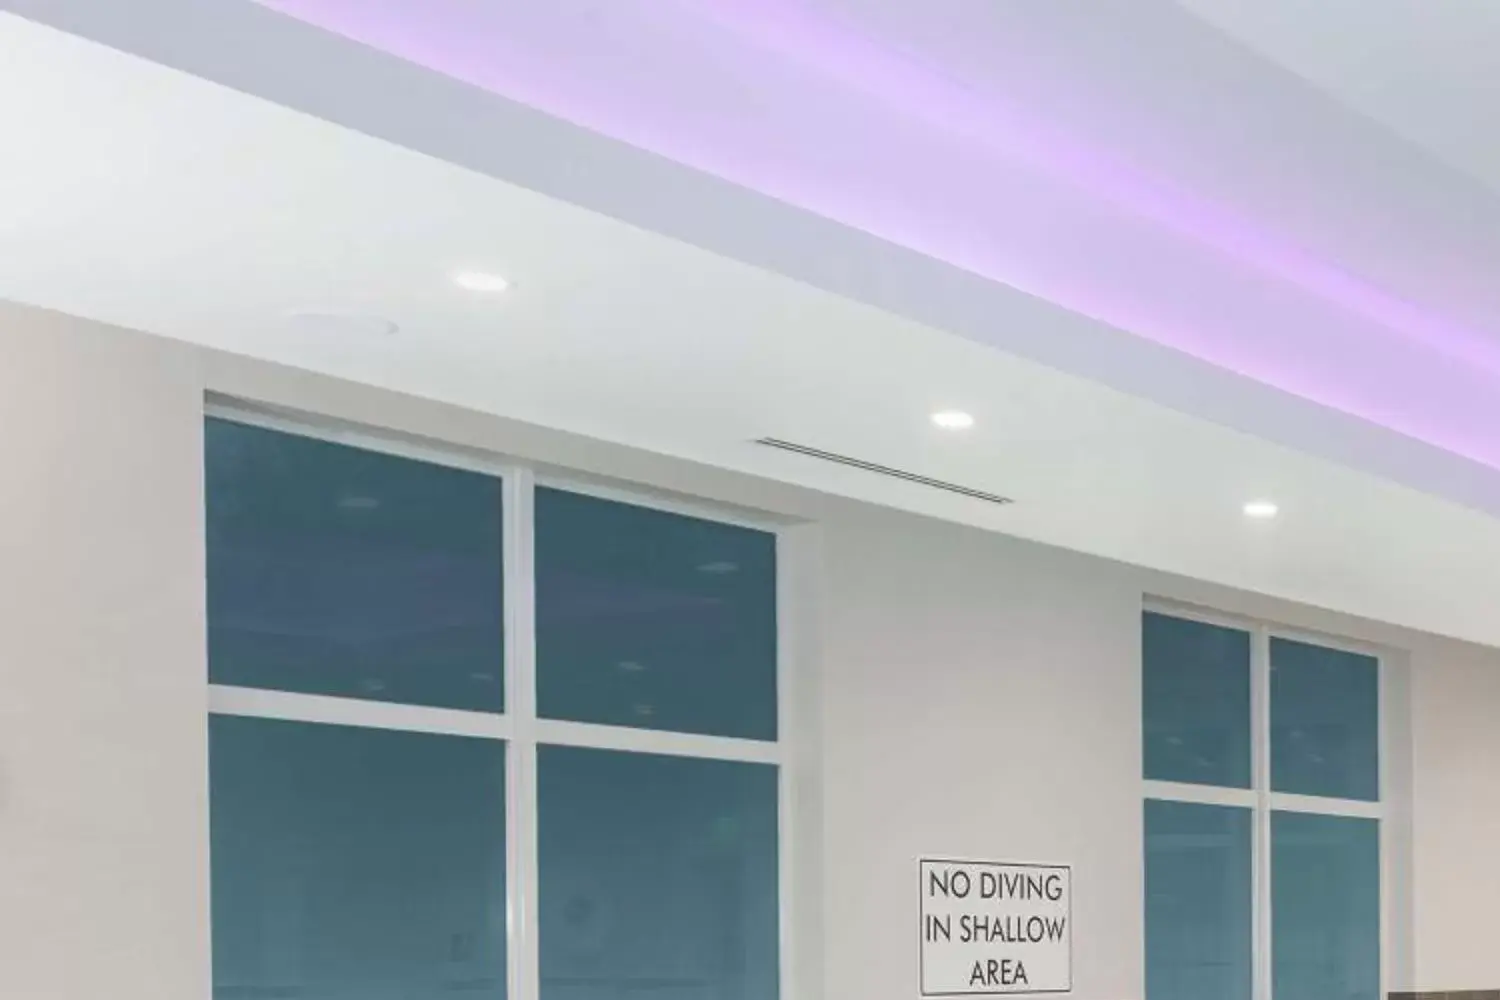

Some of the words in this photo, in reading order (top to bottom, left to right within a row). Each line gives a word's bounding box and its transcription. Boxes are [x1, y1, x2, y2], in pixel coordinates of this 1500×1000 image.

[929, 870, 971, 898] NO
[980, 872, 1063, 900] DIVING
[926, 914, 951, 942] IN
[959, 914, 1066, 943] SHALLOW
[969, 959, 1029, 986] AREA
